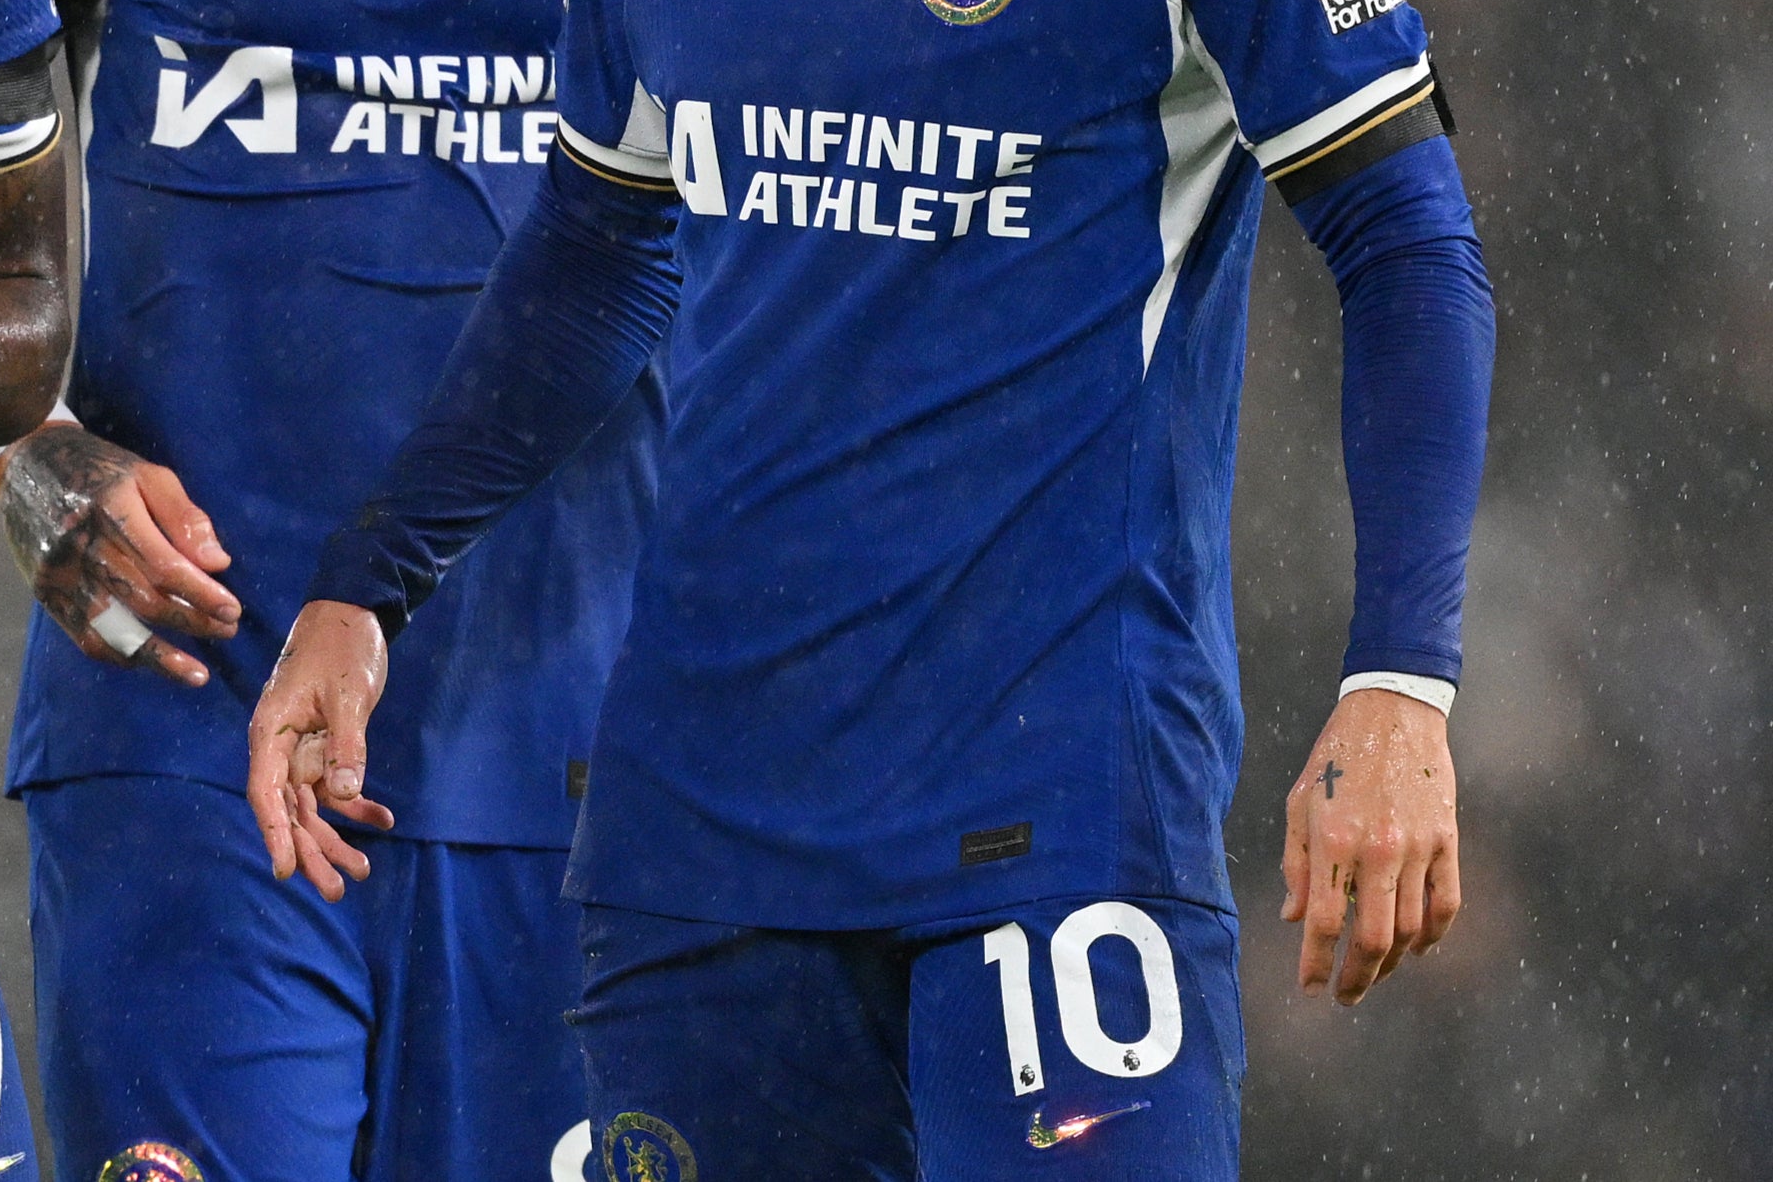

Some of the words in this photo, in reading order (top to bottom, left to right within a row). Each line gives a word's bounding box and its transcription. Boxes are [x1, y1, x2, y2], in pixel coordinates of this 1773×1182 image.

[1327, 1, 1361, 34] for
[335, 55, 556, 105] INFIN
[742, 104, 1042, 180] INFINITE
[739, 171, 1032, 242] ATHLETE
[984, 901, 1182, 1096] 10
